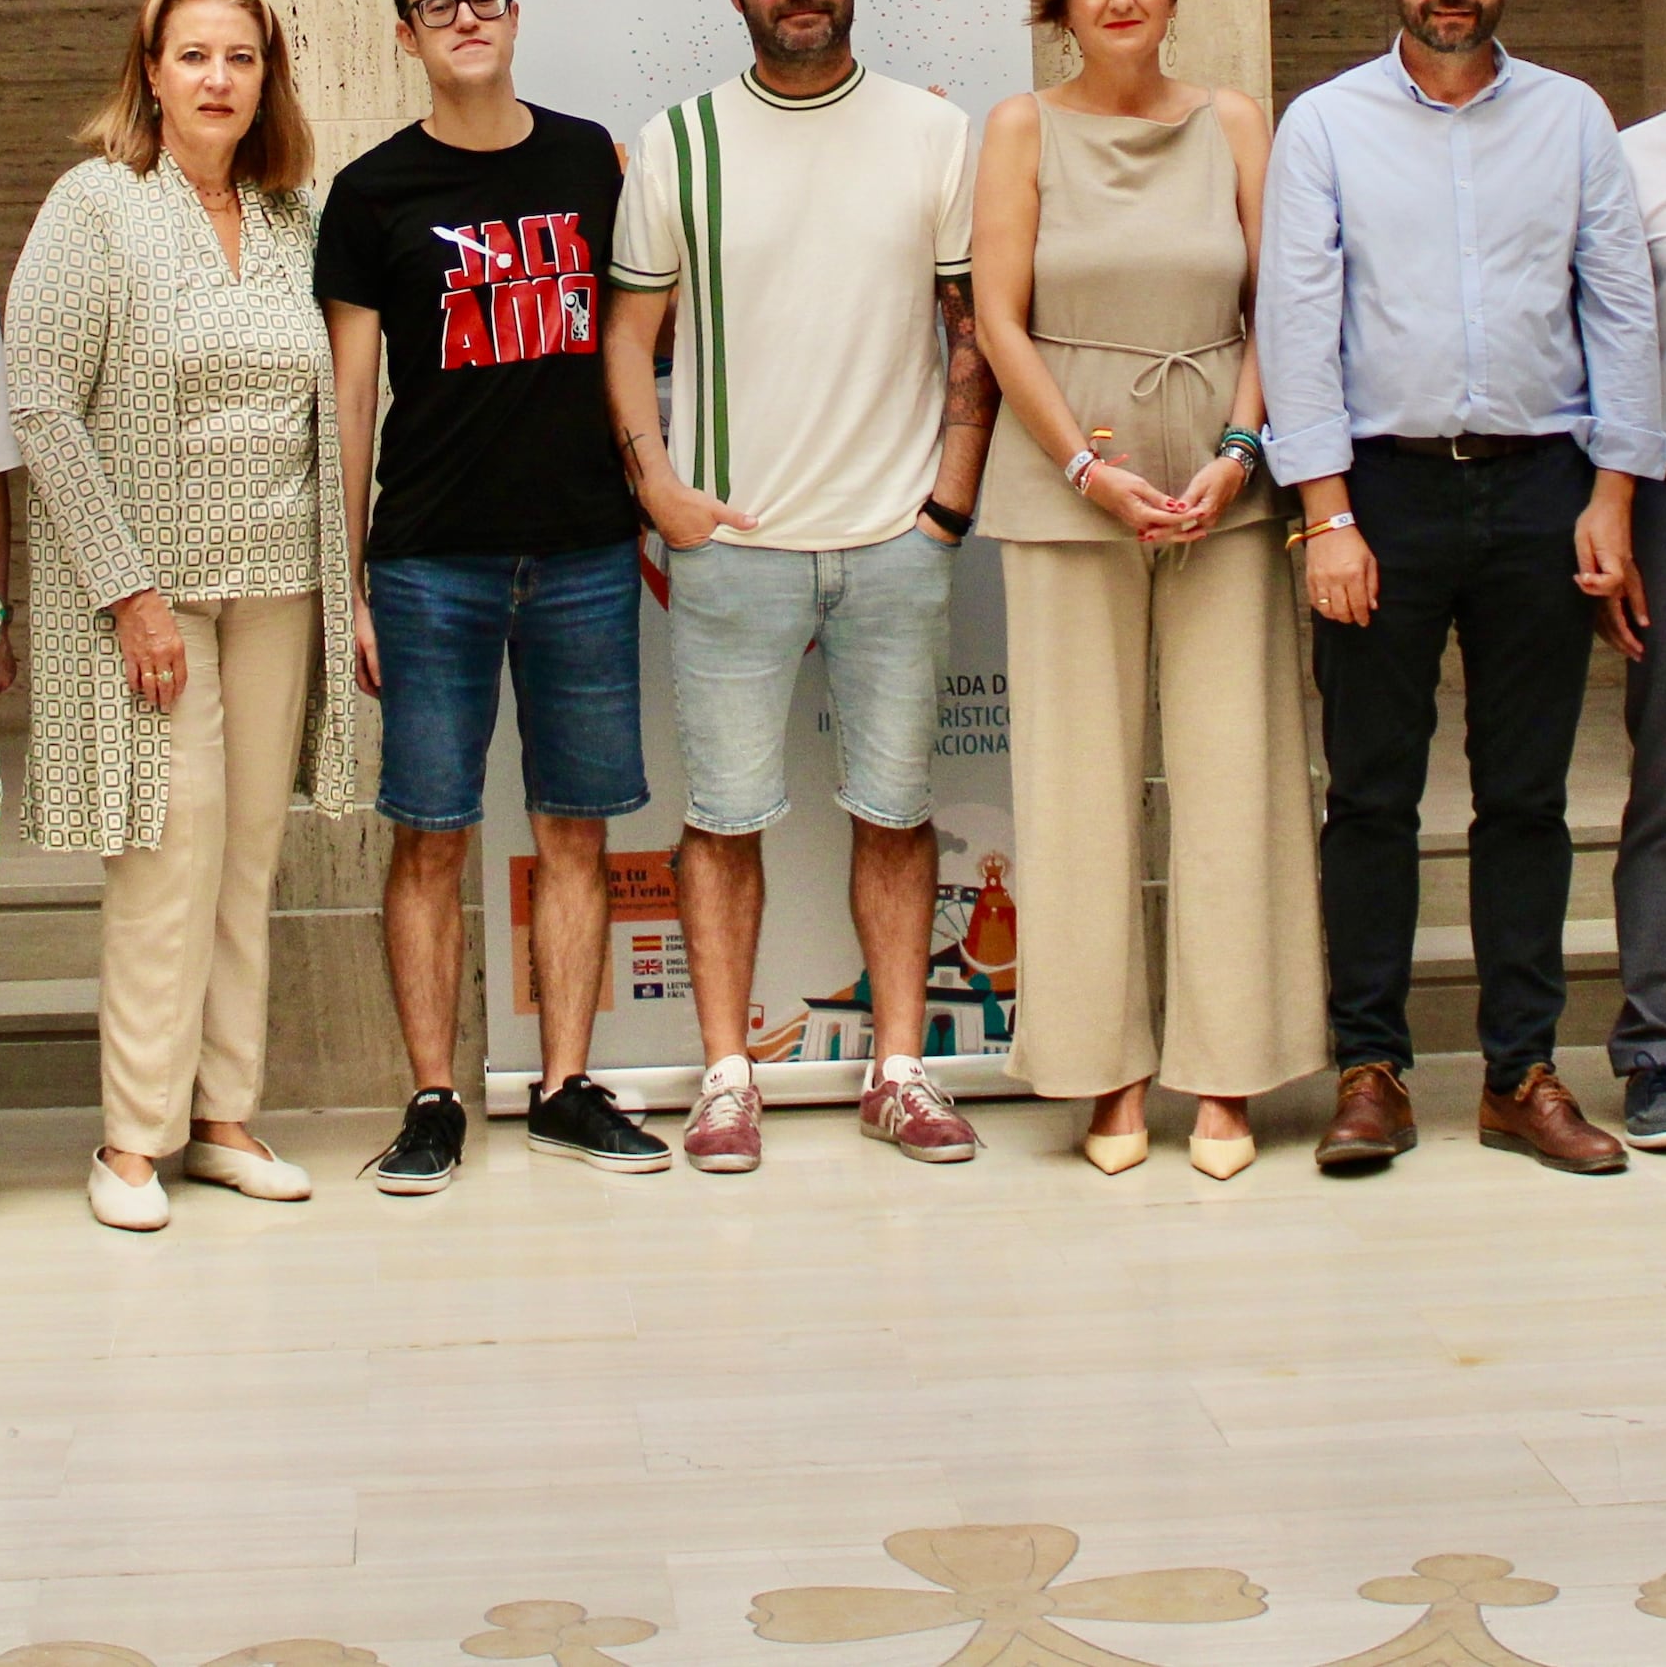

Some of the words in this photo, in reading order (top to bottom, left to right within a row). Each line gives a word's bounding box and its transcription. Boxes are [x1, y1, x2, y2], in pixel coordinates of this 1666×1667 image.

[444, 213, 592, 289] JACK
[440, 273, 598, 370] AMO
[946, 675, 986, 696] ADA
[992, 674, 1008, 695] D
[939, 702, 1010, 728] RÍSTIC
[934, 734, 1009, 756] ACIONA
[626, 868, 647, 882] tu
[630, 884, 671, 898] Feria
[665, 934, 685, 942] VERS
